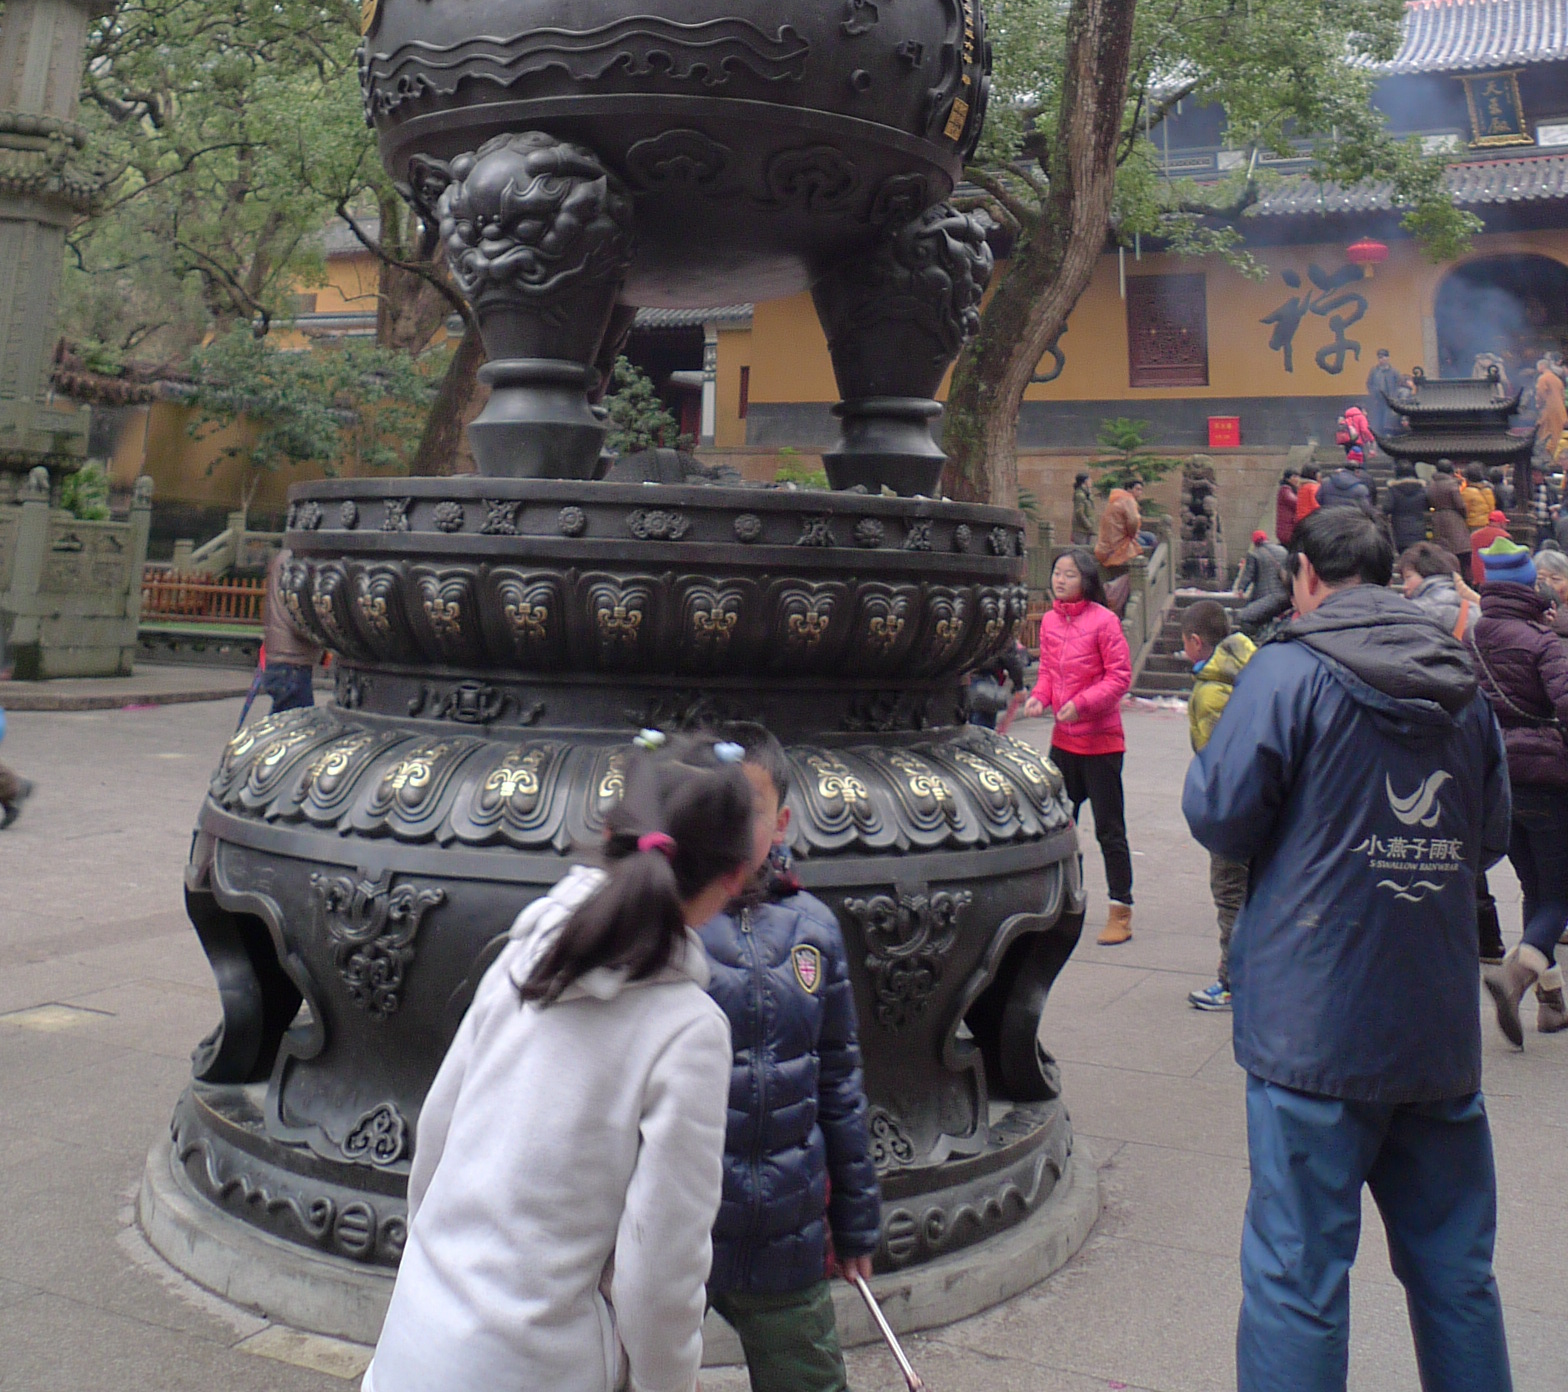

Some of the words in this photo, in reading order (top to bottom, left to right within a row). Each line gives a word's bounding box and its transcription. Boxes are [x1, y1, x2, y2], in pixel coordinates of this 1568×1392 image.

[1350, 834, 1467, 860] 小燕子雨衣
